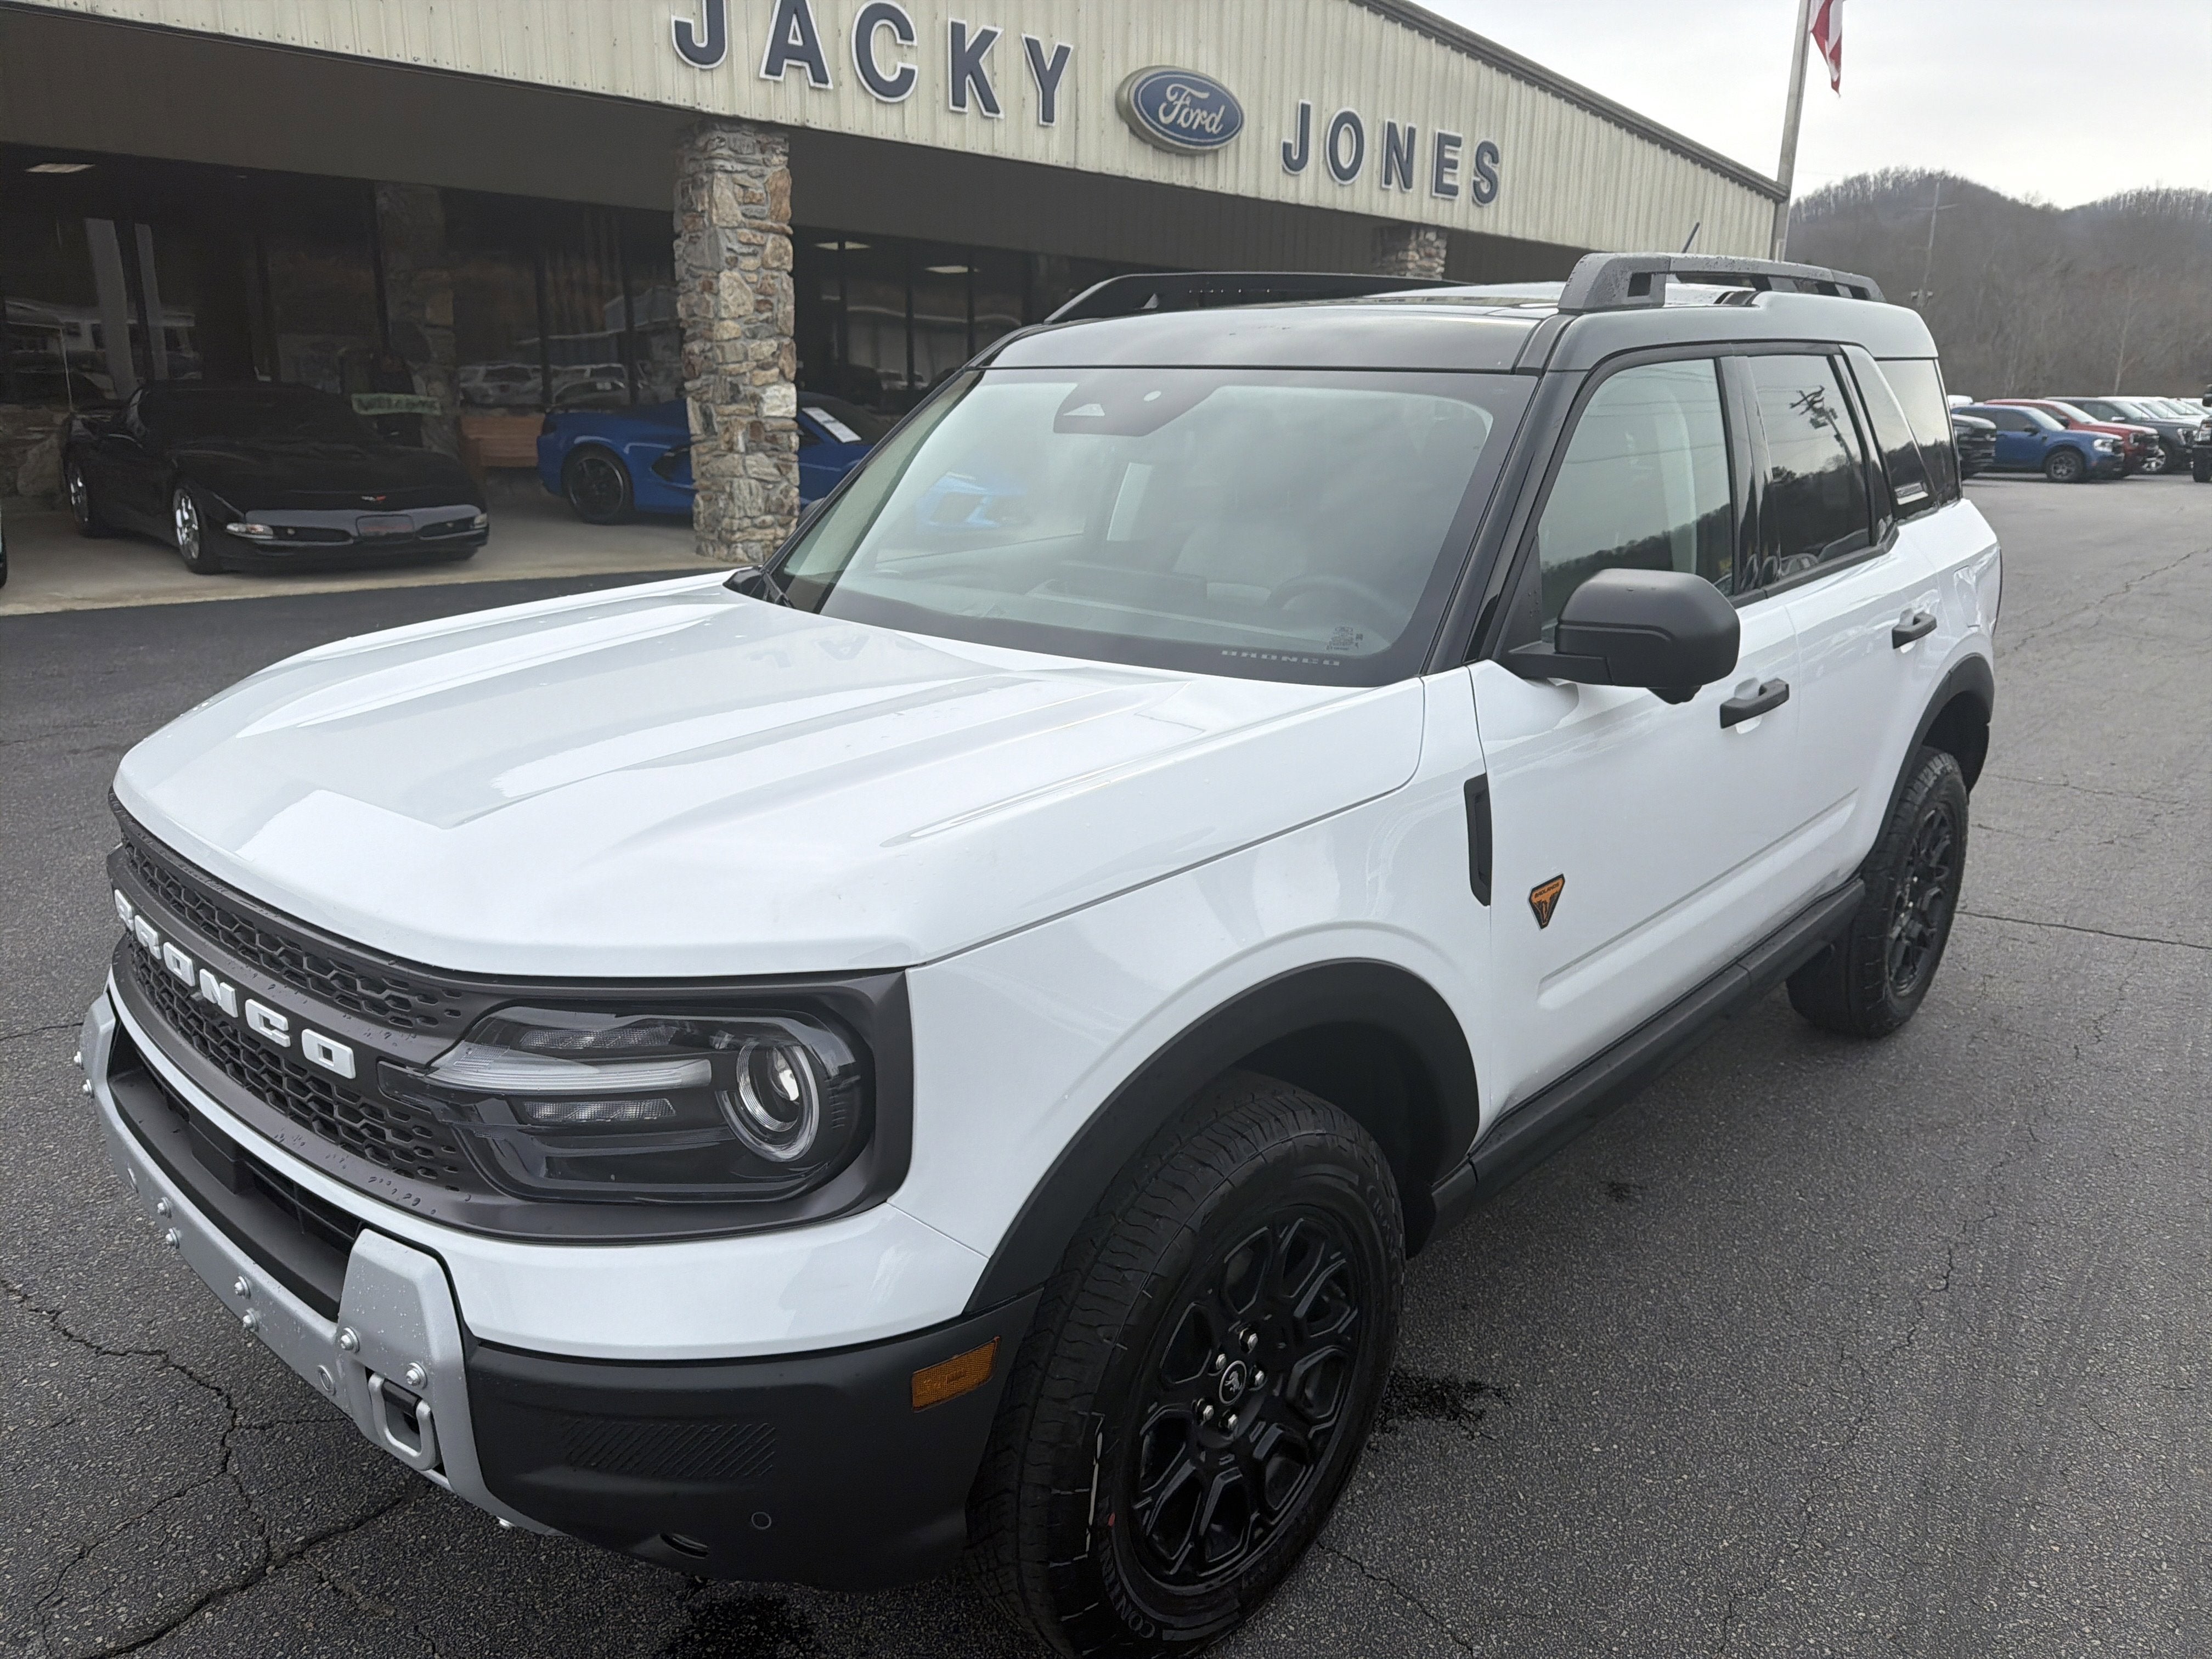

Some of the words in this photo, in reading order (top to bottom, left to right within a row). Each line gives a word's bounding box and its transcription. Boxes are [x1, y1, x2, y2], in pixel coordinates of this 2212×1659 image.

[670, 0, 1073, 126] JACKY
[1282, 99, 1500, 206] JONES
[1158, 83, 1226, 135] Ford
[114, 889, 356, 1080] BRONCO
